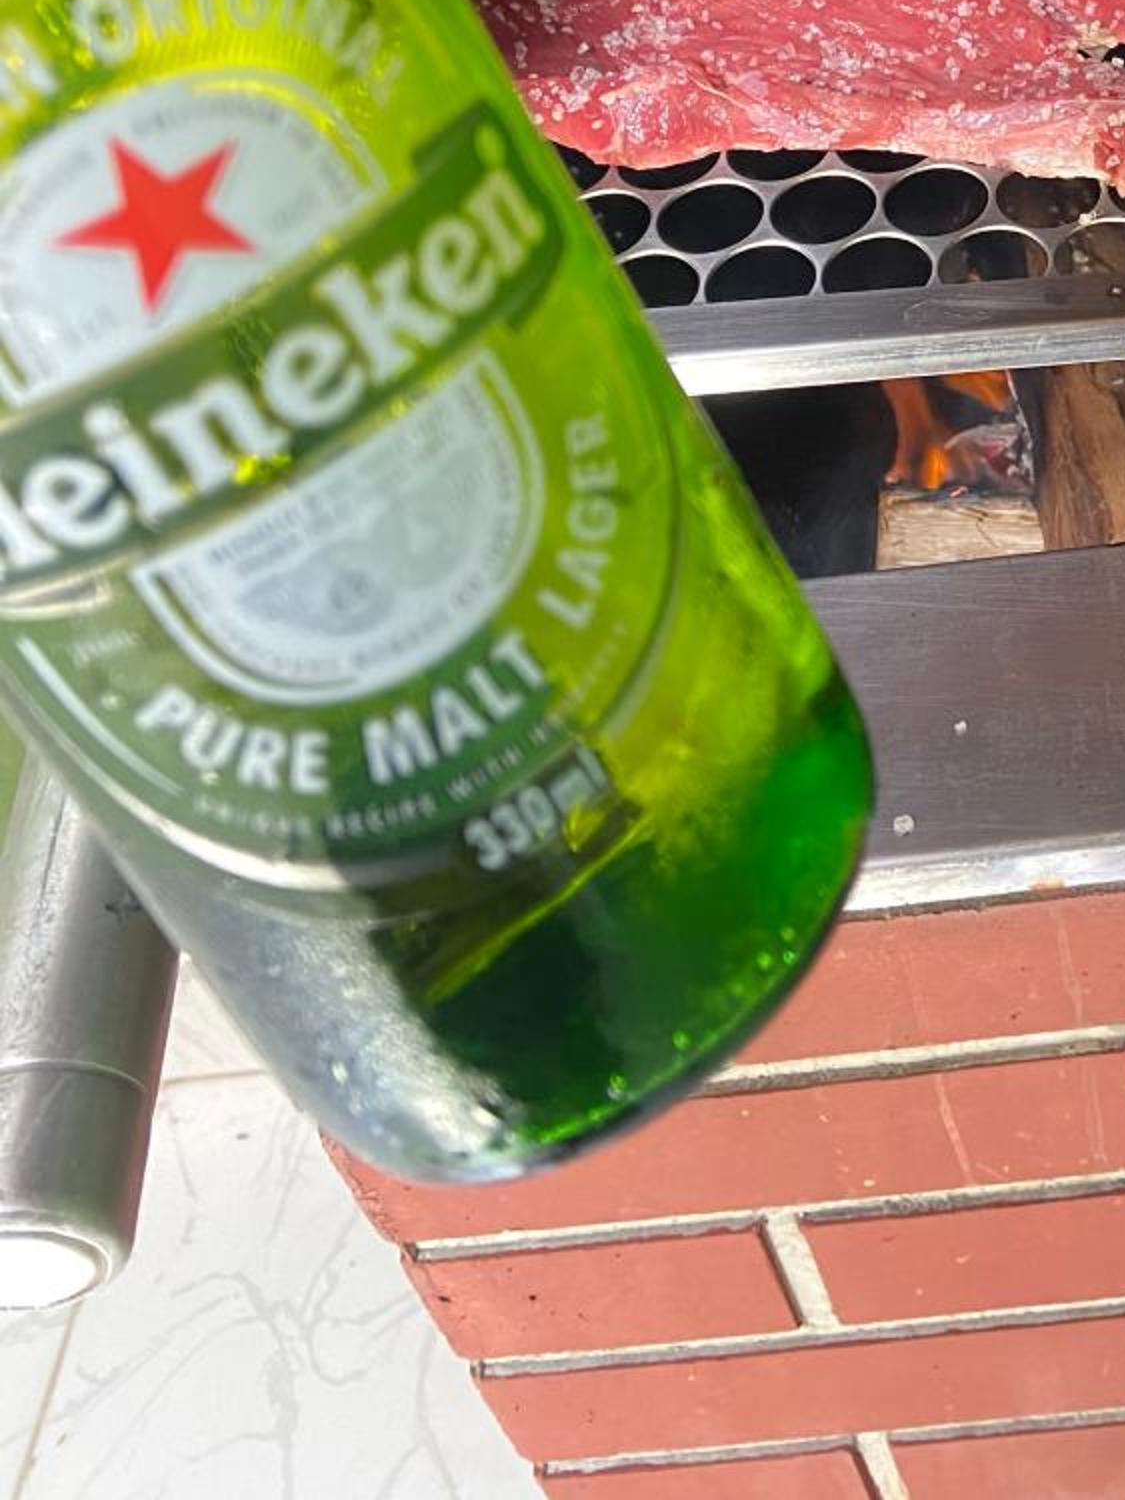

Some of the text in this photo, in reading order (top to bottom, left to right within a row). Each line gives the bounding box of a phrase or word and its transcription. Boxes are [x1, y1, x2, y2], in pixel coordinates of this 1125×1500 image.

[134, 686, 330, 794] PURE
[361, 631, 546, 786] MALT
[537, 410, 620, 631] LAGER
[463, 745, 610, 871] 330ml
